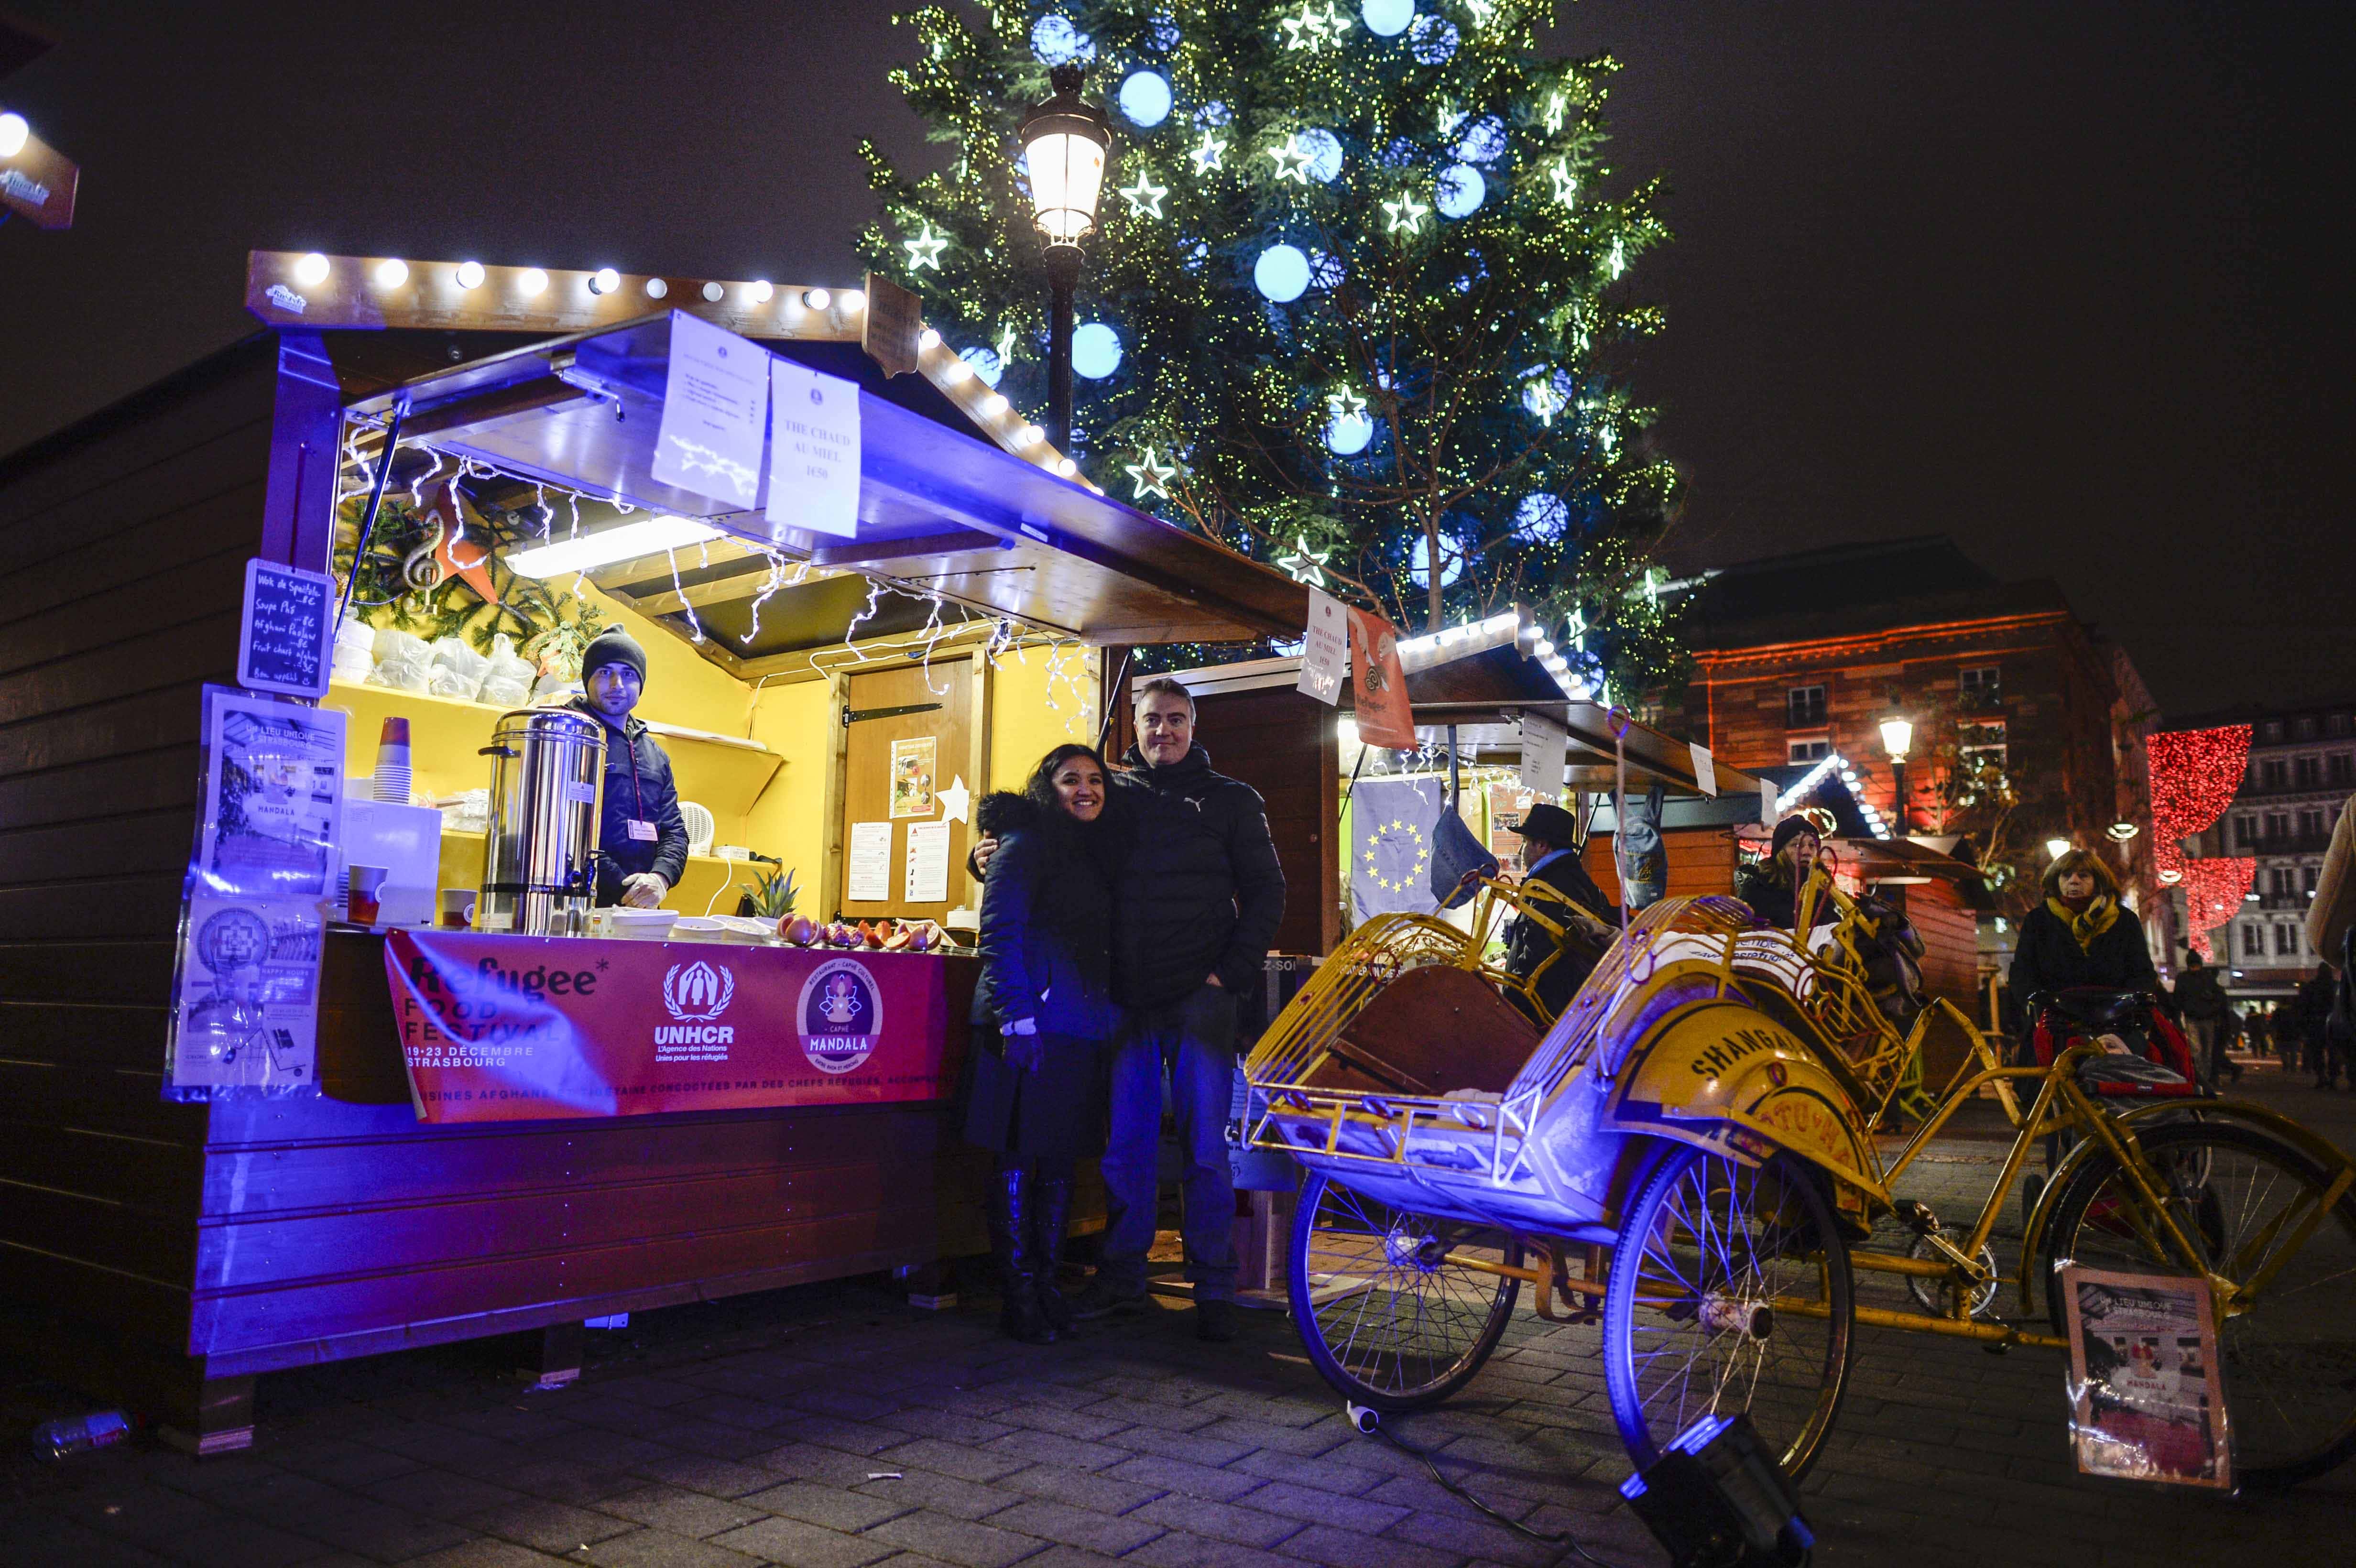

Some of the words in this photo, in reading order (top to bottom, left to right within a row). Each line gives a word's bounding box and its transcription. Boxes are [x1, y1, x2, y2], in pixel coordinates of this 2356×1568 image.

[811, 426, 850, 446] CHAUD
[277, 579, 286, 589] de
[256, 599, 277, 615] Soupe
[1324, 631, 1342, 645] CHAUD
[252, 641, 271, 652] Fruit
[1315, 641, 1323, 649] AU
[1324, 643, 1336, 655] MIEL
[261, 726, 281, 735] LIEU
[284, 729, 316, 740] UNIQUE
[258, 735, 312, 748] STRASBOURG
[258, 806, 294, 816] MANDALA
[809, 962, 836, 985] RESTAURANT
[405, 998, 498, 1019] FOOD
[405, 1022, 560, 1043] FESTIVAL
[654, 1025, 734, 1045] UNHCR
[449, 1045, 534, 1056] DÉCEMBRE
[810, 1037, 867, 1051] MANDALA
[407, 1057, 506, 1067] STRASBOURG
[701, 1053, 728, 1062] réfugiés
[735, 1080, 757, 1089] PAR
[762, 1079, 784, 1089] DES
[788, 1078, 823, 1088] CHEFS
[2115, 1298, 2135, 1307] LIEU
[2138, 1300, 2173, 1310] UNIQUE
[2127, 1380, 2166, 1390] MANDALA
